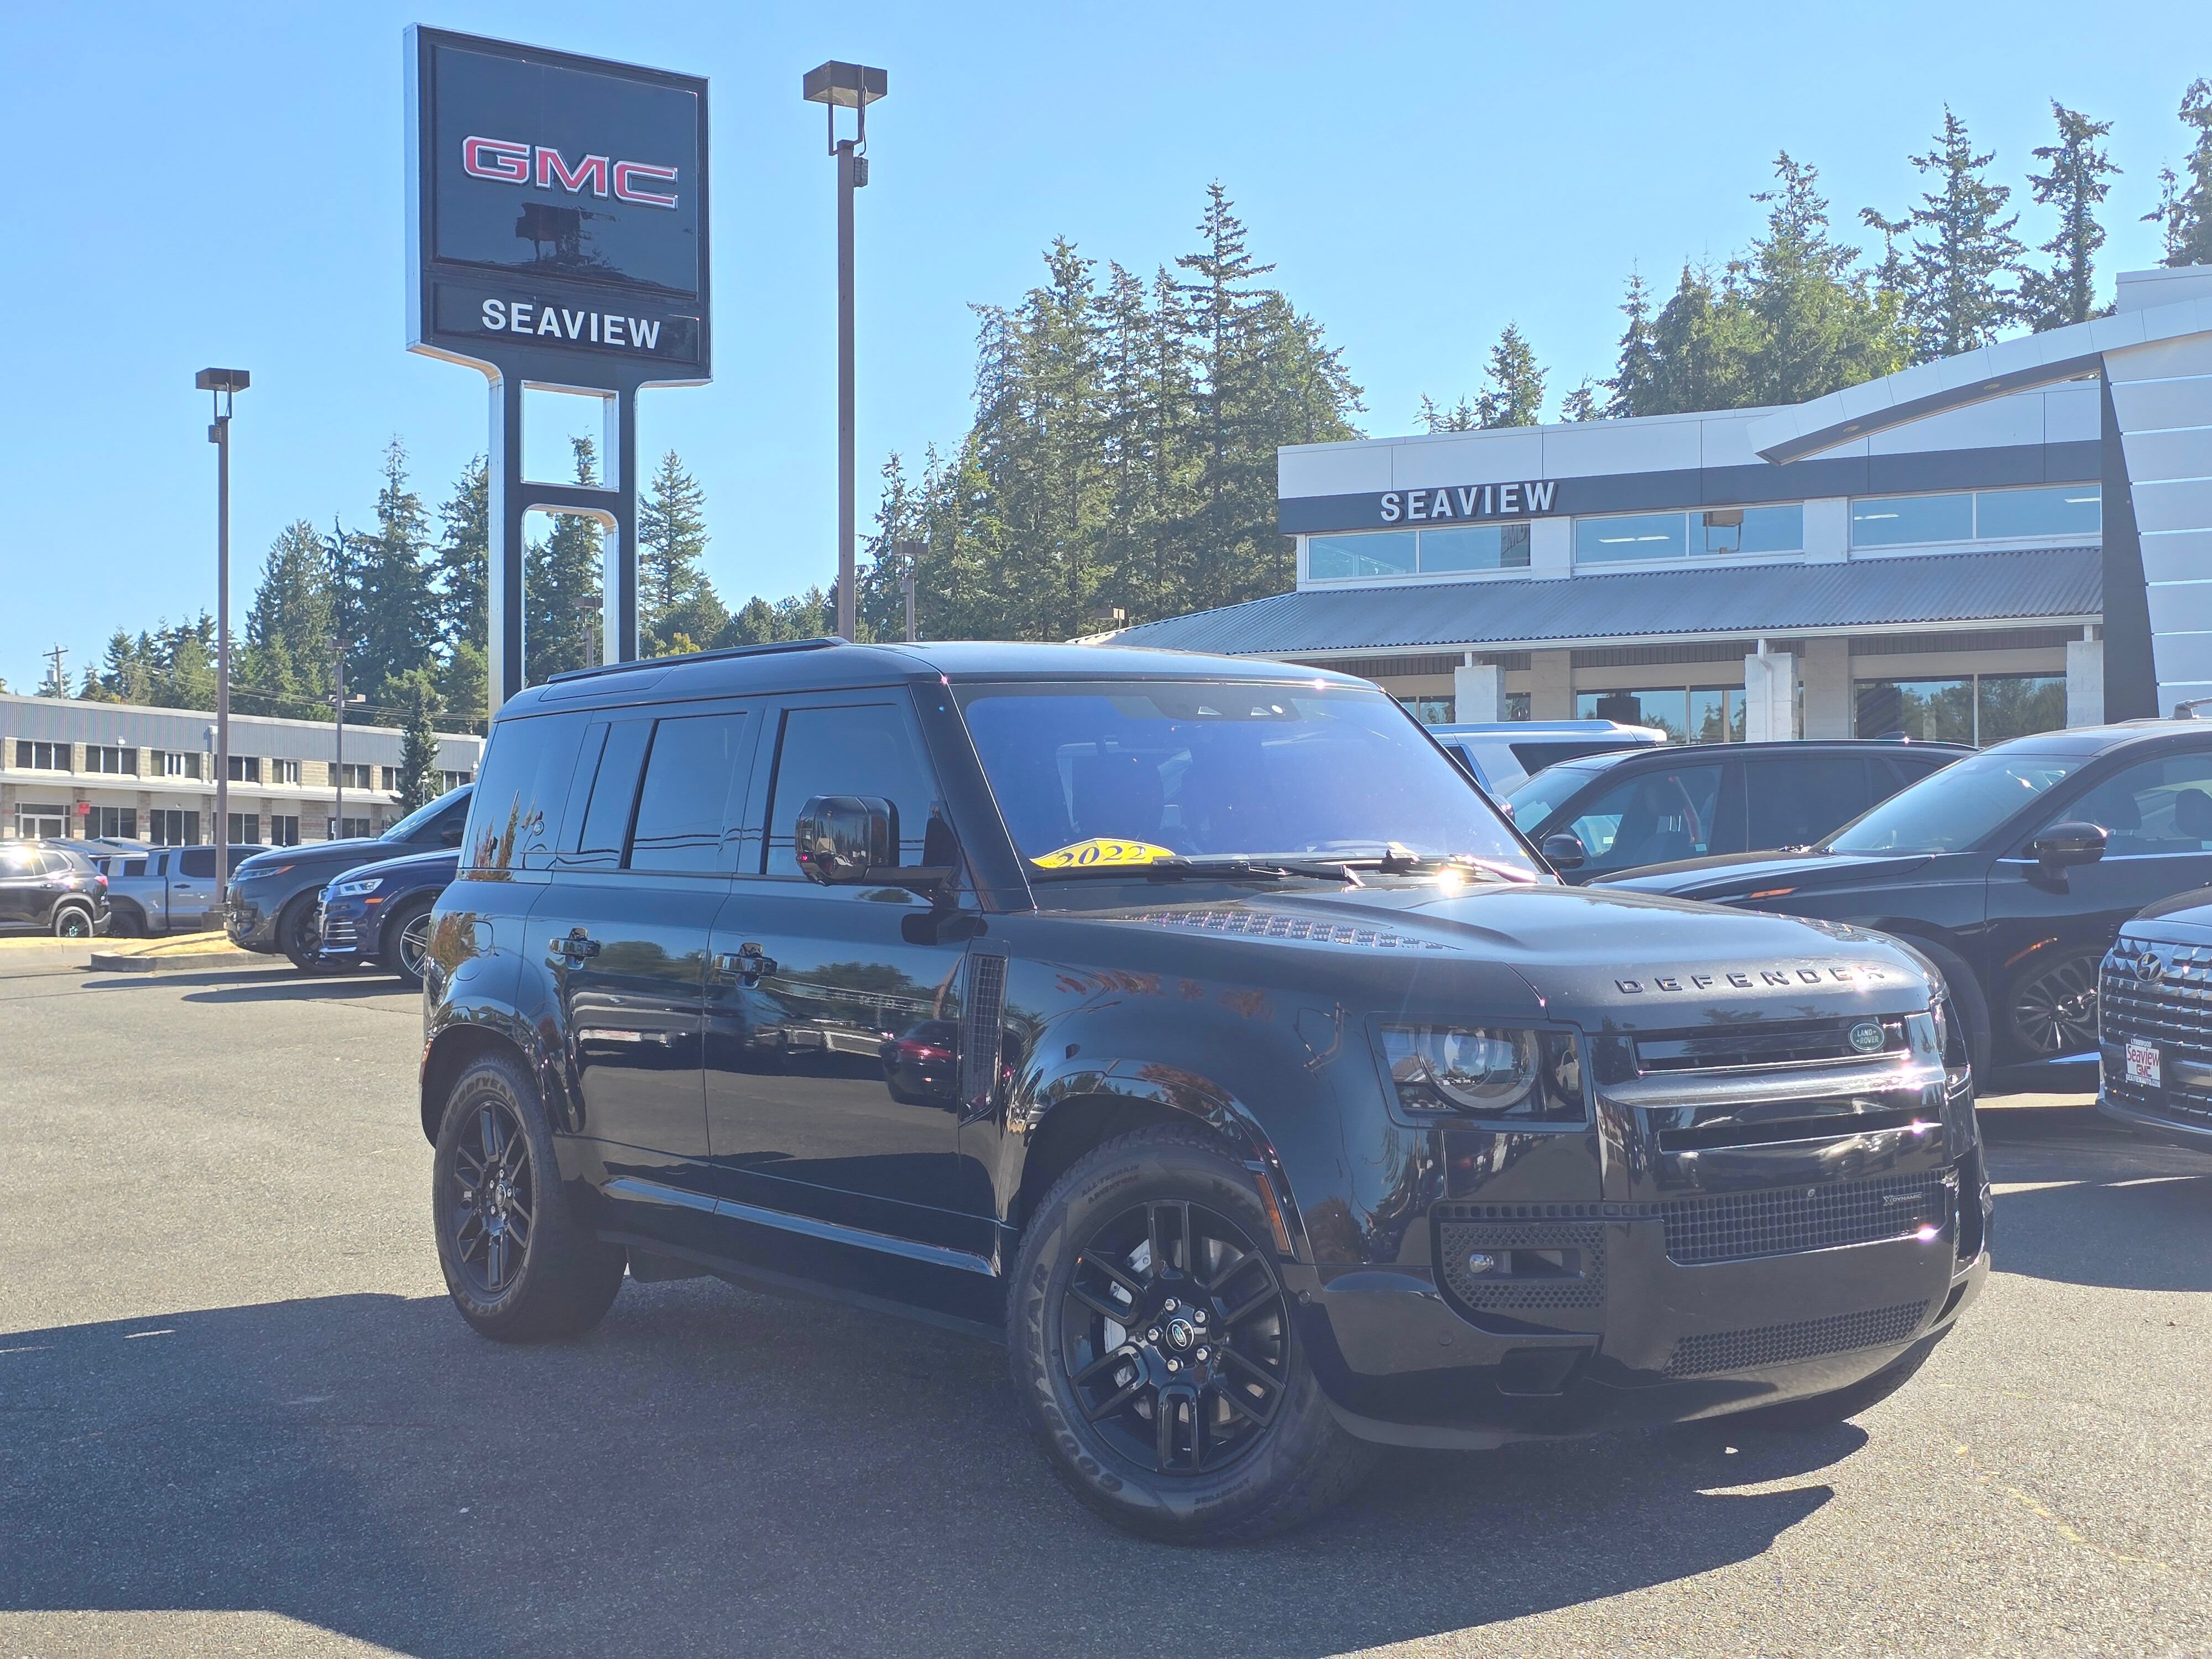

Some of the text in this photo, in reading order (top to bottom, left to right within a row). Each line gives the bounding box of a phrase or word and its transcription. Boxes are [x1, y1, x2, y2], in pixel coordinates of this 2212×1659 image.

[462, 135, 678, 209] GMC
[482, 299, 660, 349] SEAVIEW
[1380, 481, 1556, 521] SEAVIEW
[1056, 845, 1146, 868] 2022
[1615, 966, 1885, 994] DEFENDER
[1857, 1029, 1872, 1037] LAND
[1860, 1035, 1879, 1044] ROVER
[2127, 1045, 2160, 1066] Seaview
[2136, 1064, 2152, 1077] GMC
[445, 1077, 517, 1133] GOODYEAR
